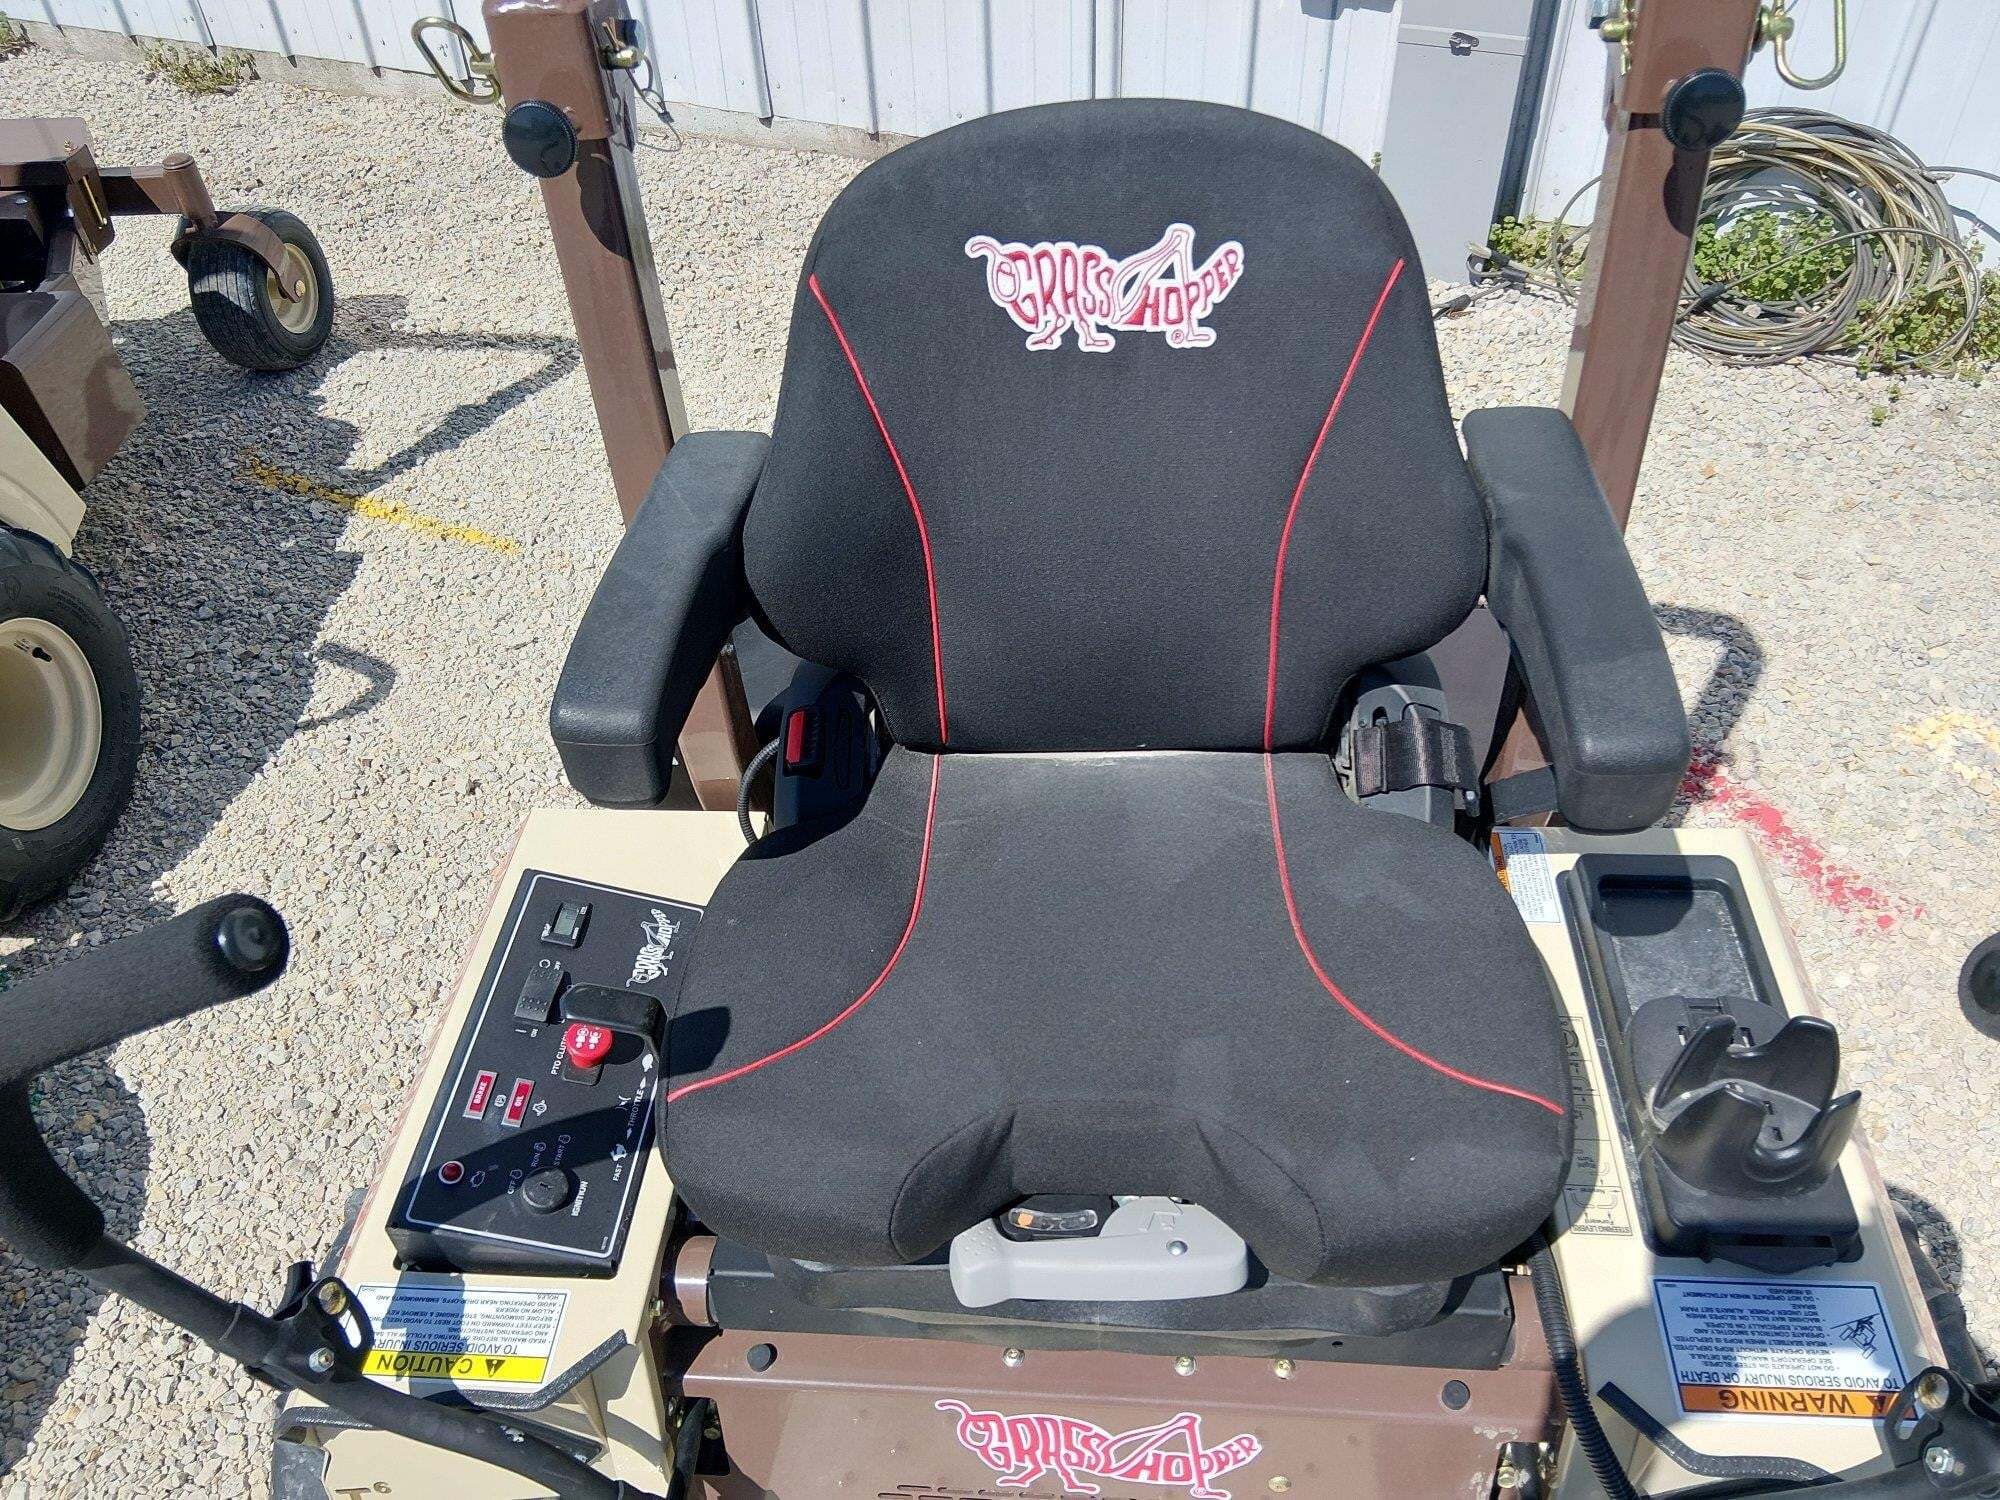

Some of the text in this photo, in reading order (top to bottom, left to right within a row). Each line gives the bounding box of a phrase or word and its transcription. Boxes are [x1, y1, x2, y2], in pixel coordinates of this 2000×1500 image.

[551, 1059, 562, 1075] PTO
[473, 1081, 488, 1104] BRAKE
[514, 1095, 525, 1107] OIL
[628, 1088, 644, 1127] THROTTLE
[531, 1152, 541, 1168] RUN
[612, 1164, 623, 1182] FAST
[571, 1180, 589, 1217] IGNITION
[413, 1340, 464, 1351] SERIOUS
[465, 1342, 501, 1353] AVOID
[502, 1344, 519, 1354] TO
[376, 1354, 474, 1374] CAUTION
[1679, 1370, 1899, 1389] TO AVOID SERIOUS INJURY OR DEATH
[1717, 1389, 1855, 1413] WARNING
